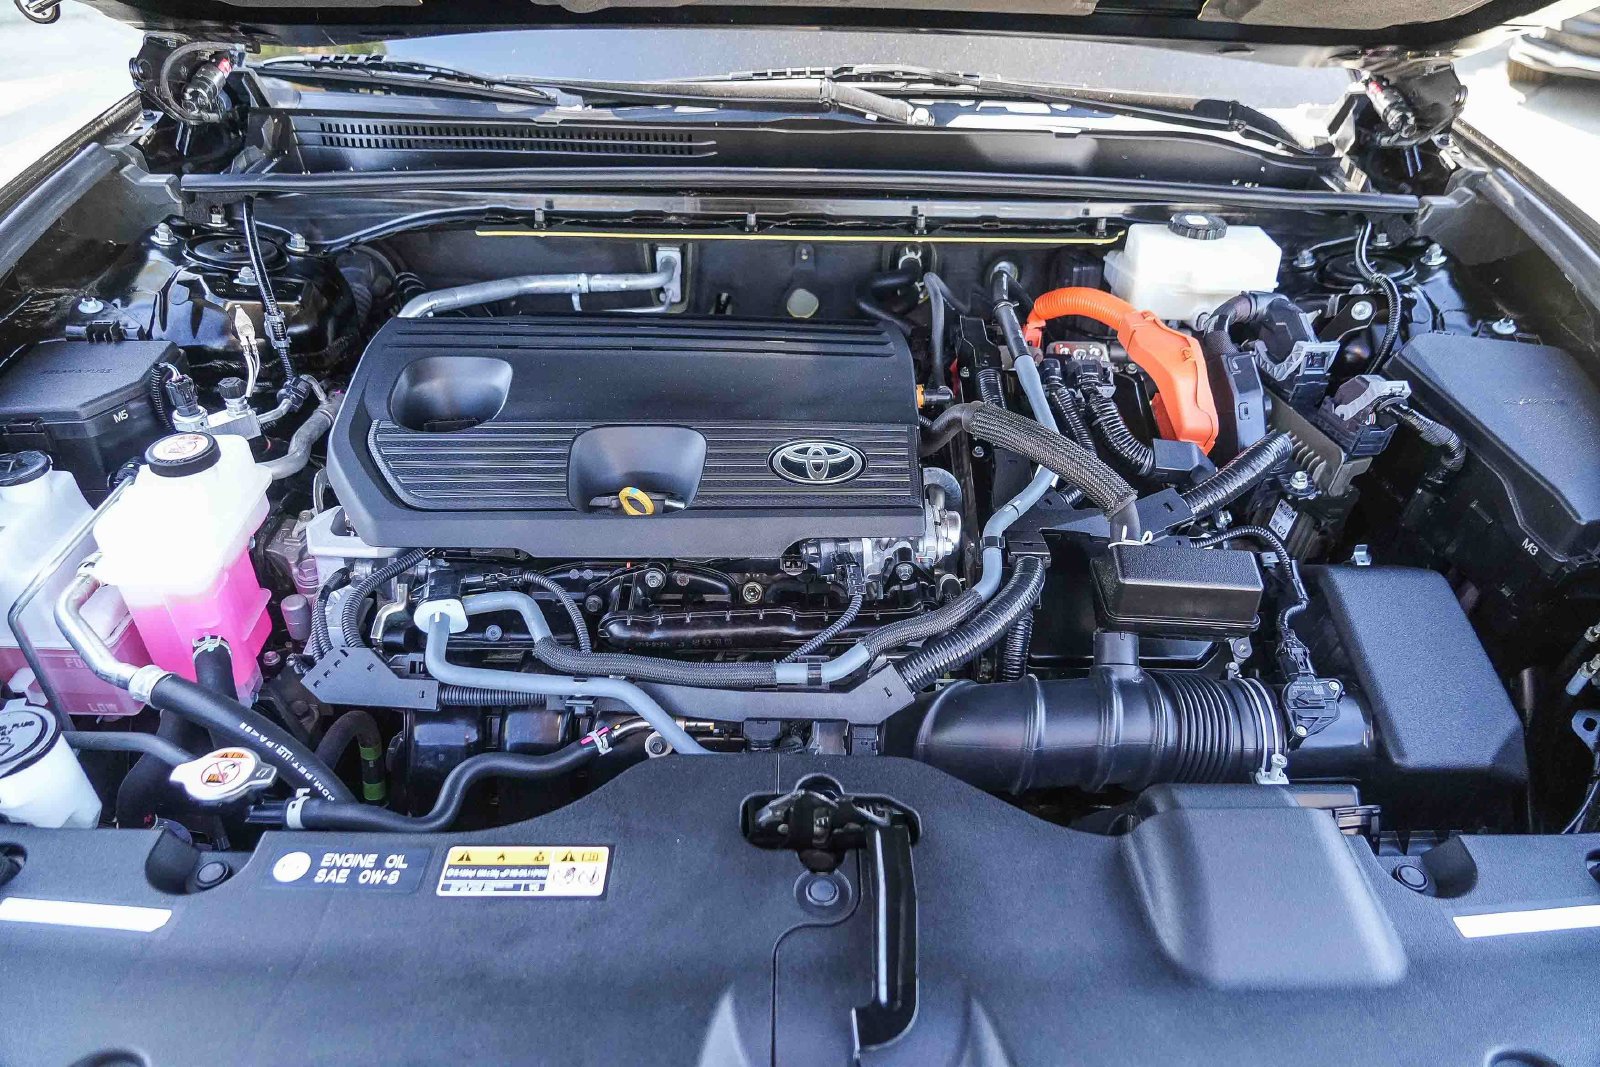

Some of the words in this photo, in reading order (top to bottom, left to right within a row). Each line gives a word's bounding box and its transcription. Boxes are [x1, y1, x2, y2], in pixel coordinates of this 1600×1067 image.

[113, 409, 129, 423] M5
[1277, 525, 1287, 537] C2
[1521, 537, 1539, 556] M3
[87, 703, 118, 713] LOW
[320, 852, 379, 868] ENGINE
[384, 854, 409, 869] OIL
[313, 868, 351, 883] SAE
